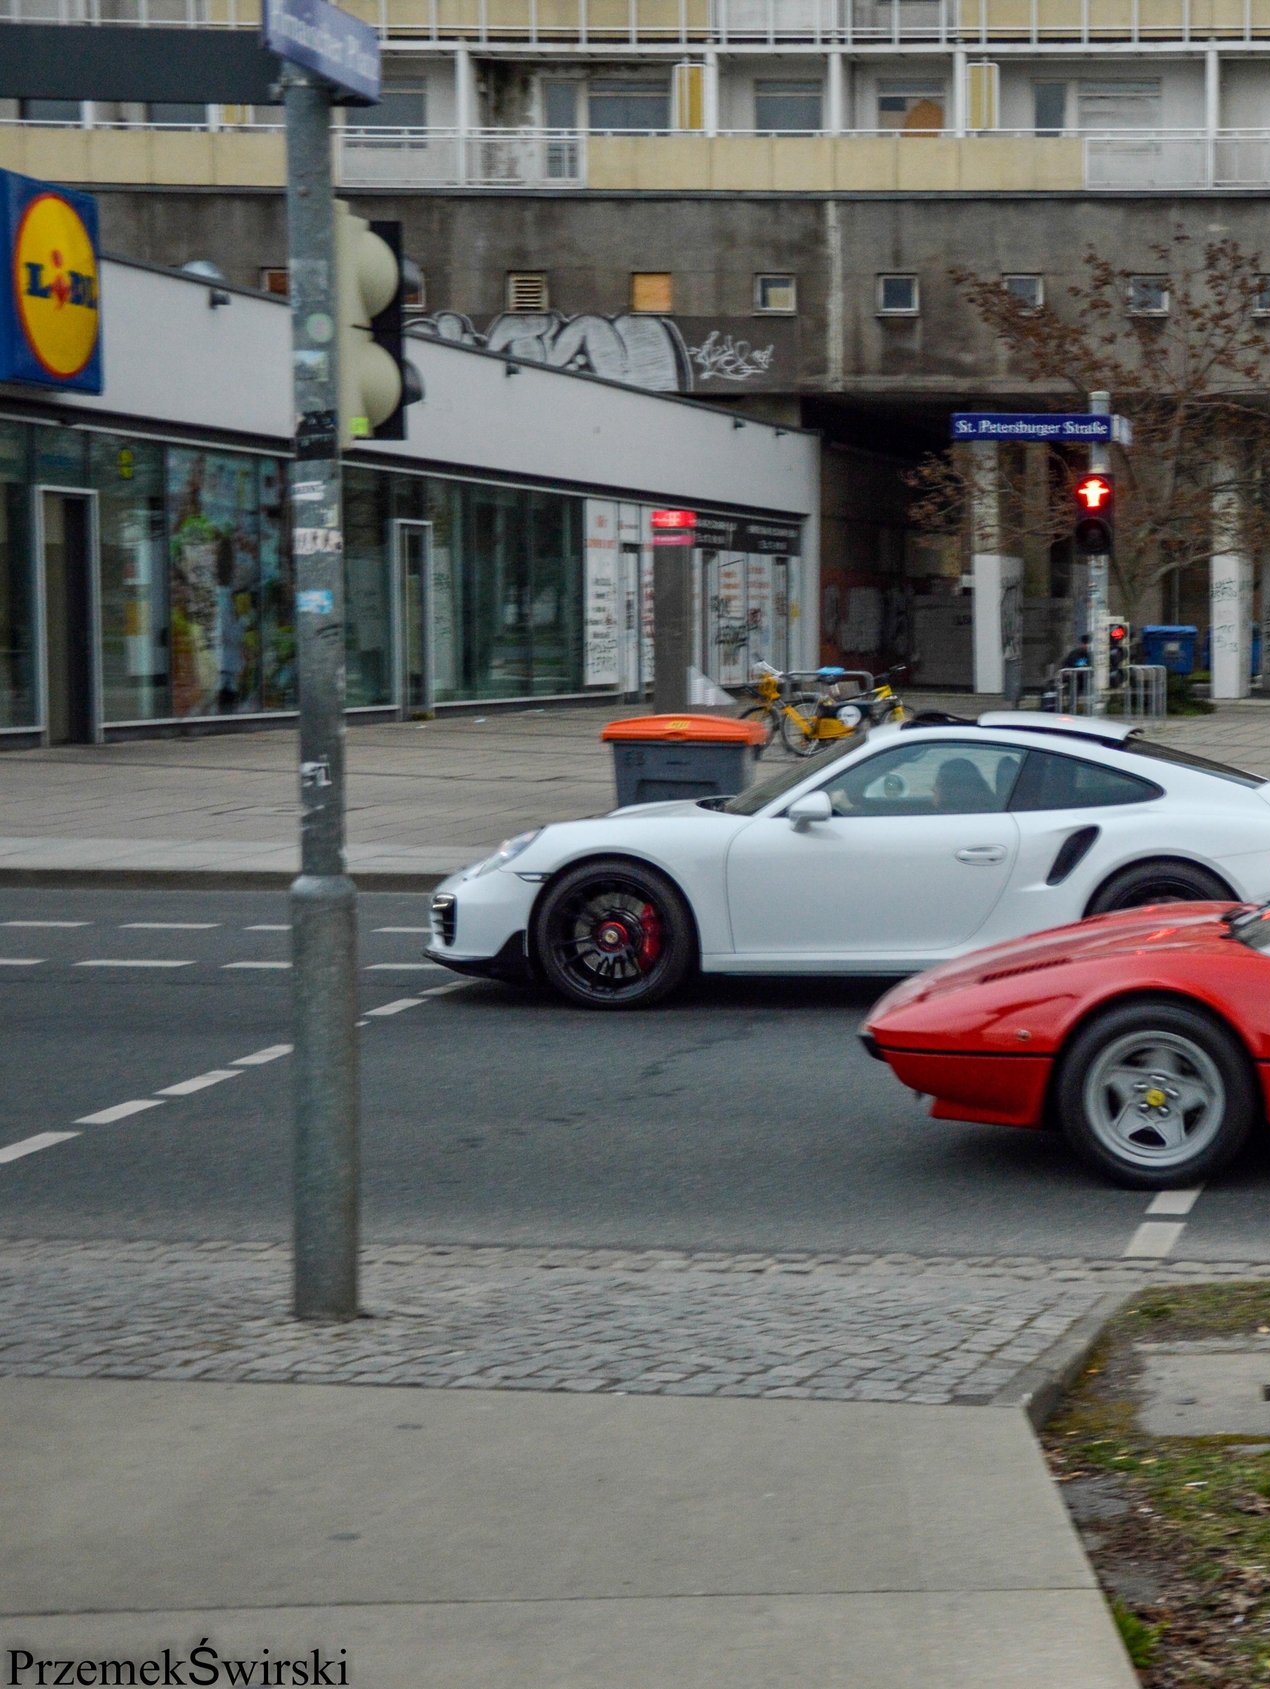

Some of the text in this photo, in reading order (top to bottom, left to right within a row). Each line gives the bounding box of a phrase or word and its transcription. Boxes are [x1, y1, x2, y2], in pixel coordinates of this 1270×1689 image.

[955, 420, 1108, 436] St. Petersburger Straße
